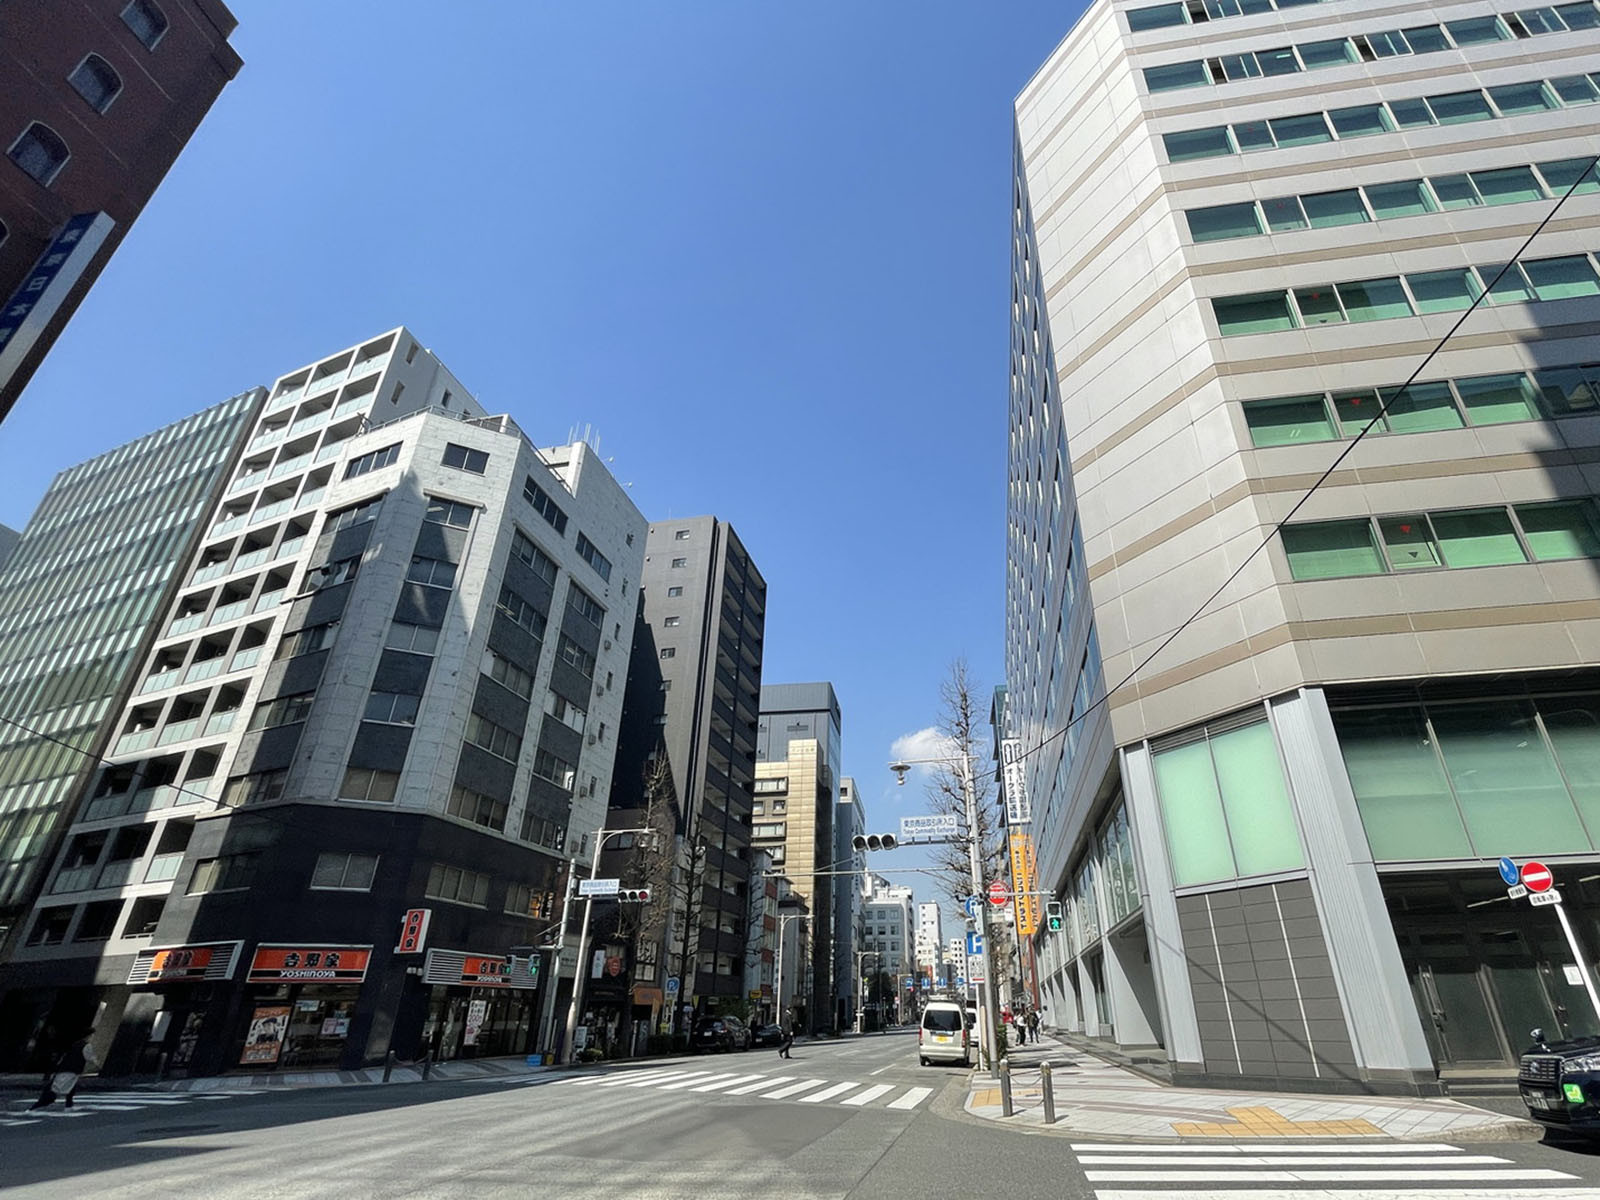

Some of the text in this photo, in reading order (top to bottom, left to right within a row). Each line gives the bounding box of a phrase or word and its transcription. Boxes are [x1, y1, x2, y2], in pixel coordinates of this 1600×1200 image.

[405, 912, 419, 948] 吉野家
[284, 951, 340, 968] 吉野家
[280, 970, 336, 979] YOSHINOYA
